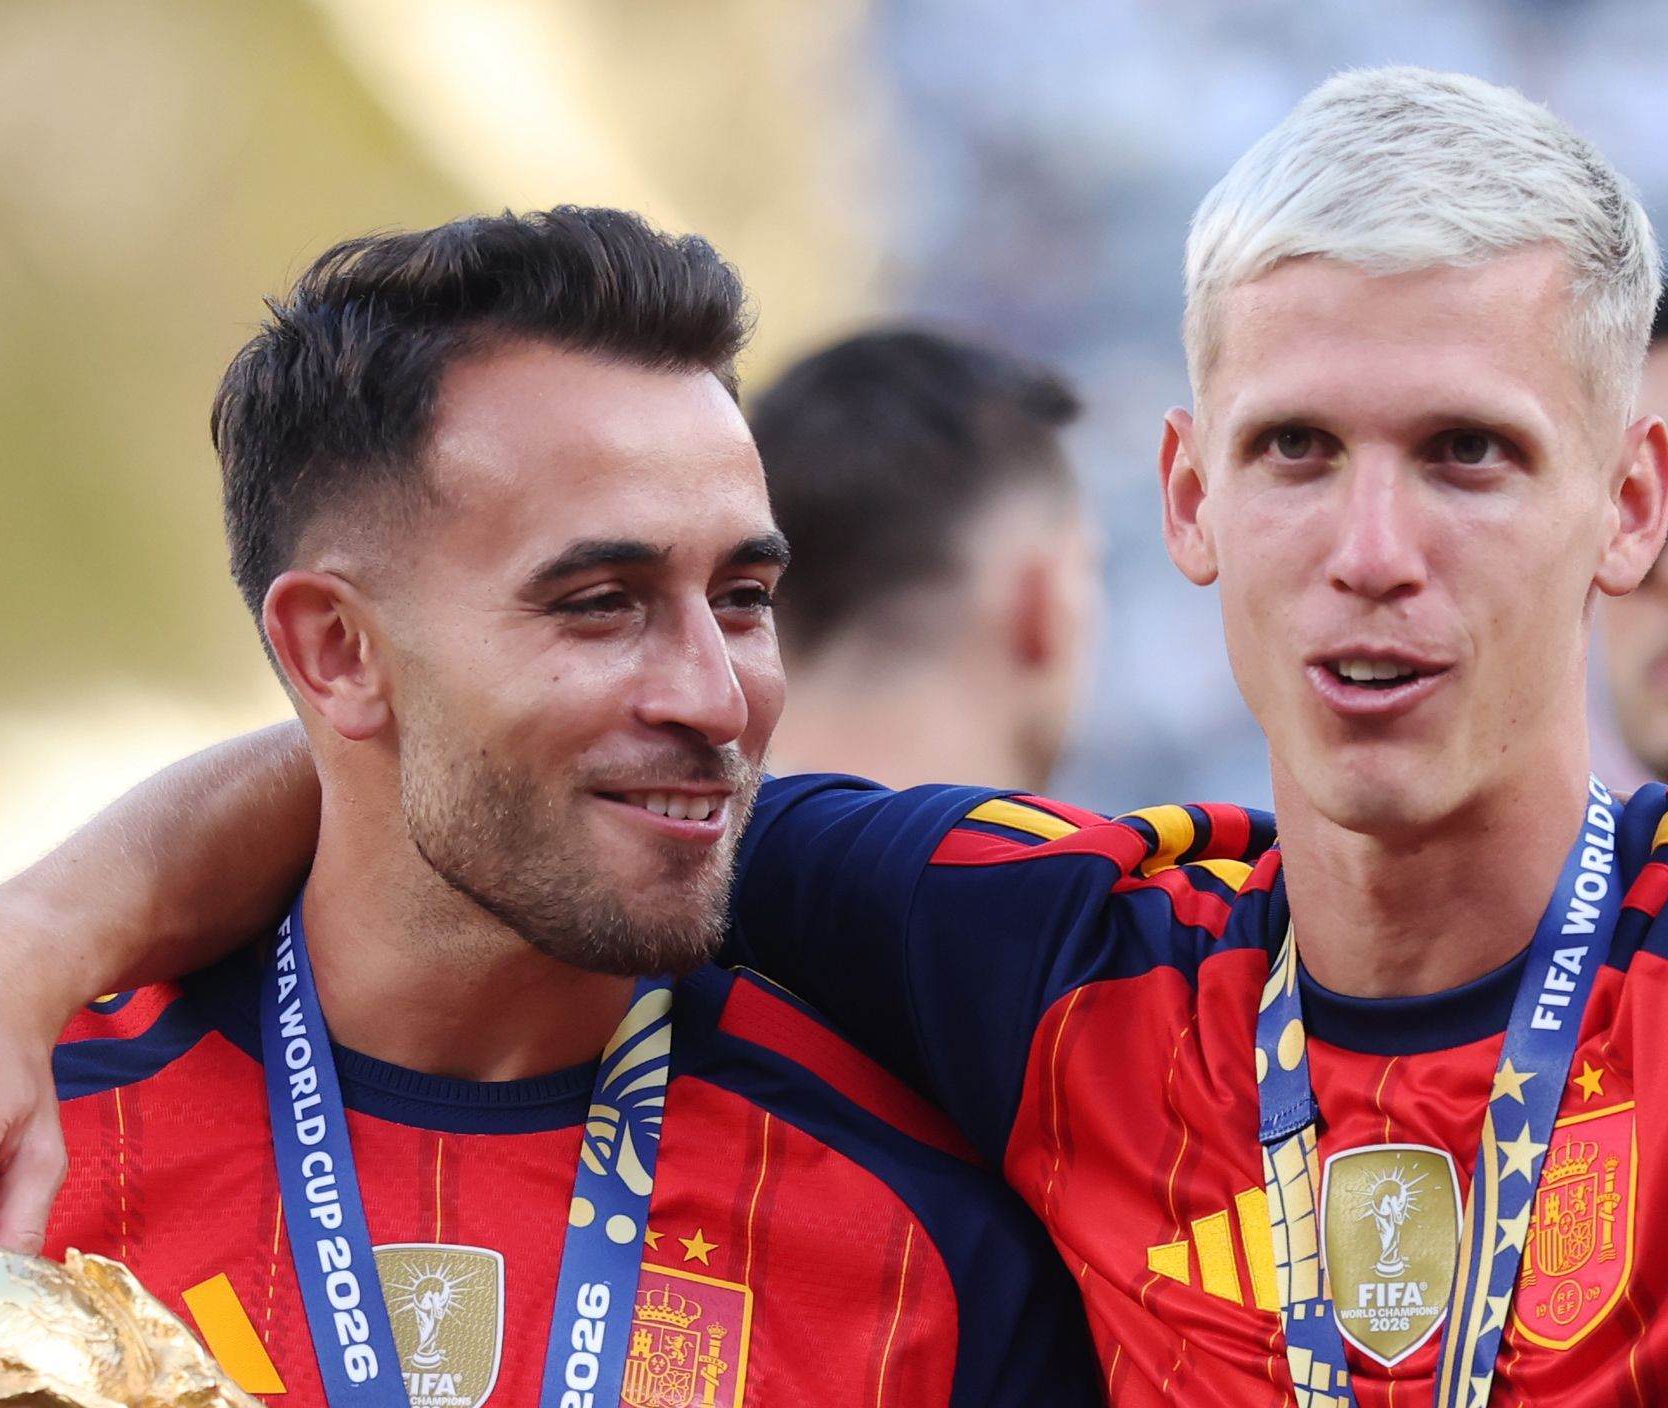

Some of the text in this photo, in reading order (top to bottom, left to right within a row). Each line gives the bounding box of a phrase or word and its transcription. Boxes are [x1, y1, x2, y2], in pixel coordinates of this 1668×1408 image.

[1530, 946, 1589, 1031] FIFA
[1560, 803, 1616, 934] WORLD
[276, 914, 379, 1383] FIFA WORLD CUP 2026
[1358, 1282, 1423, 1308] FIFA
[1340, 1306, 1439, 1320] WORLD CHAMPIONS
[1369, 1318, 1410, 1332] 2026
[410, 1396, 472, 1406] CHAMPIONS
